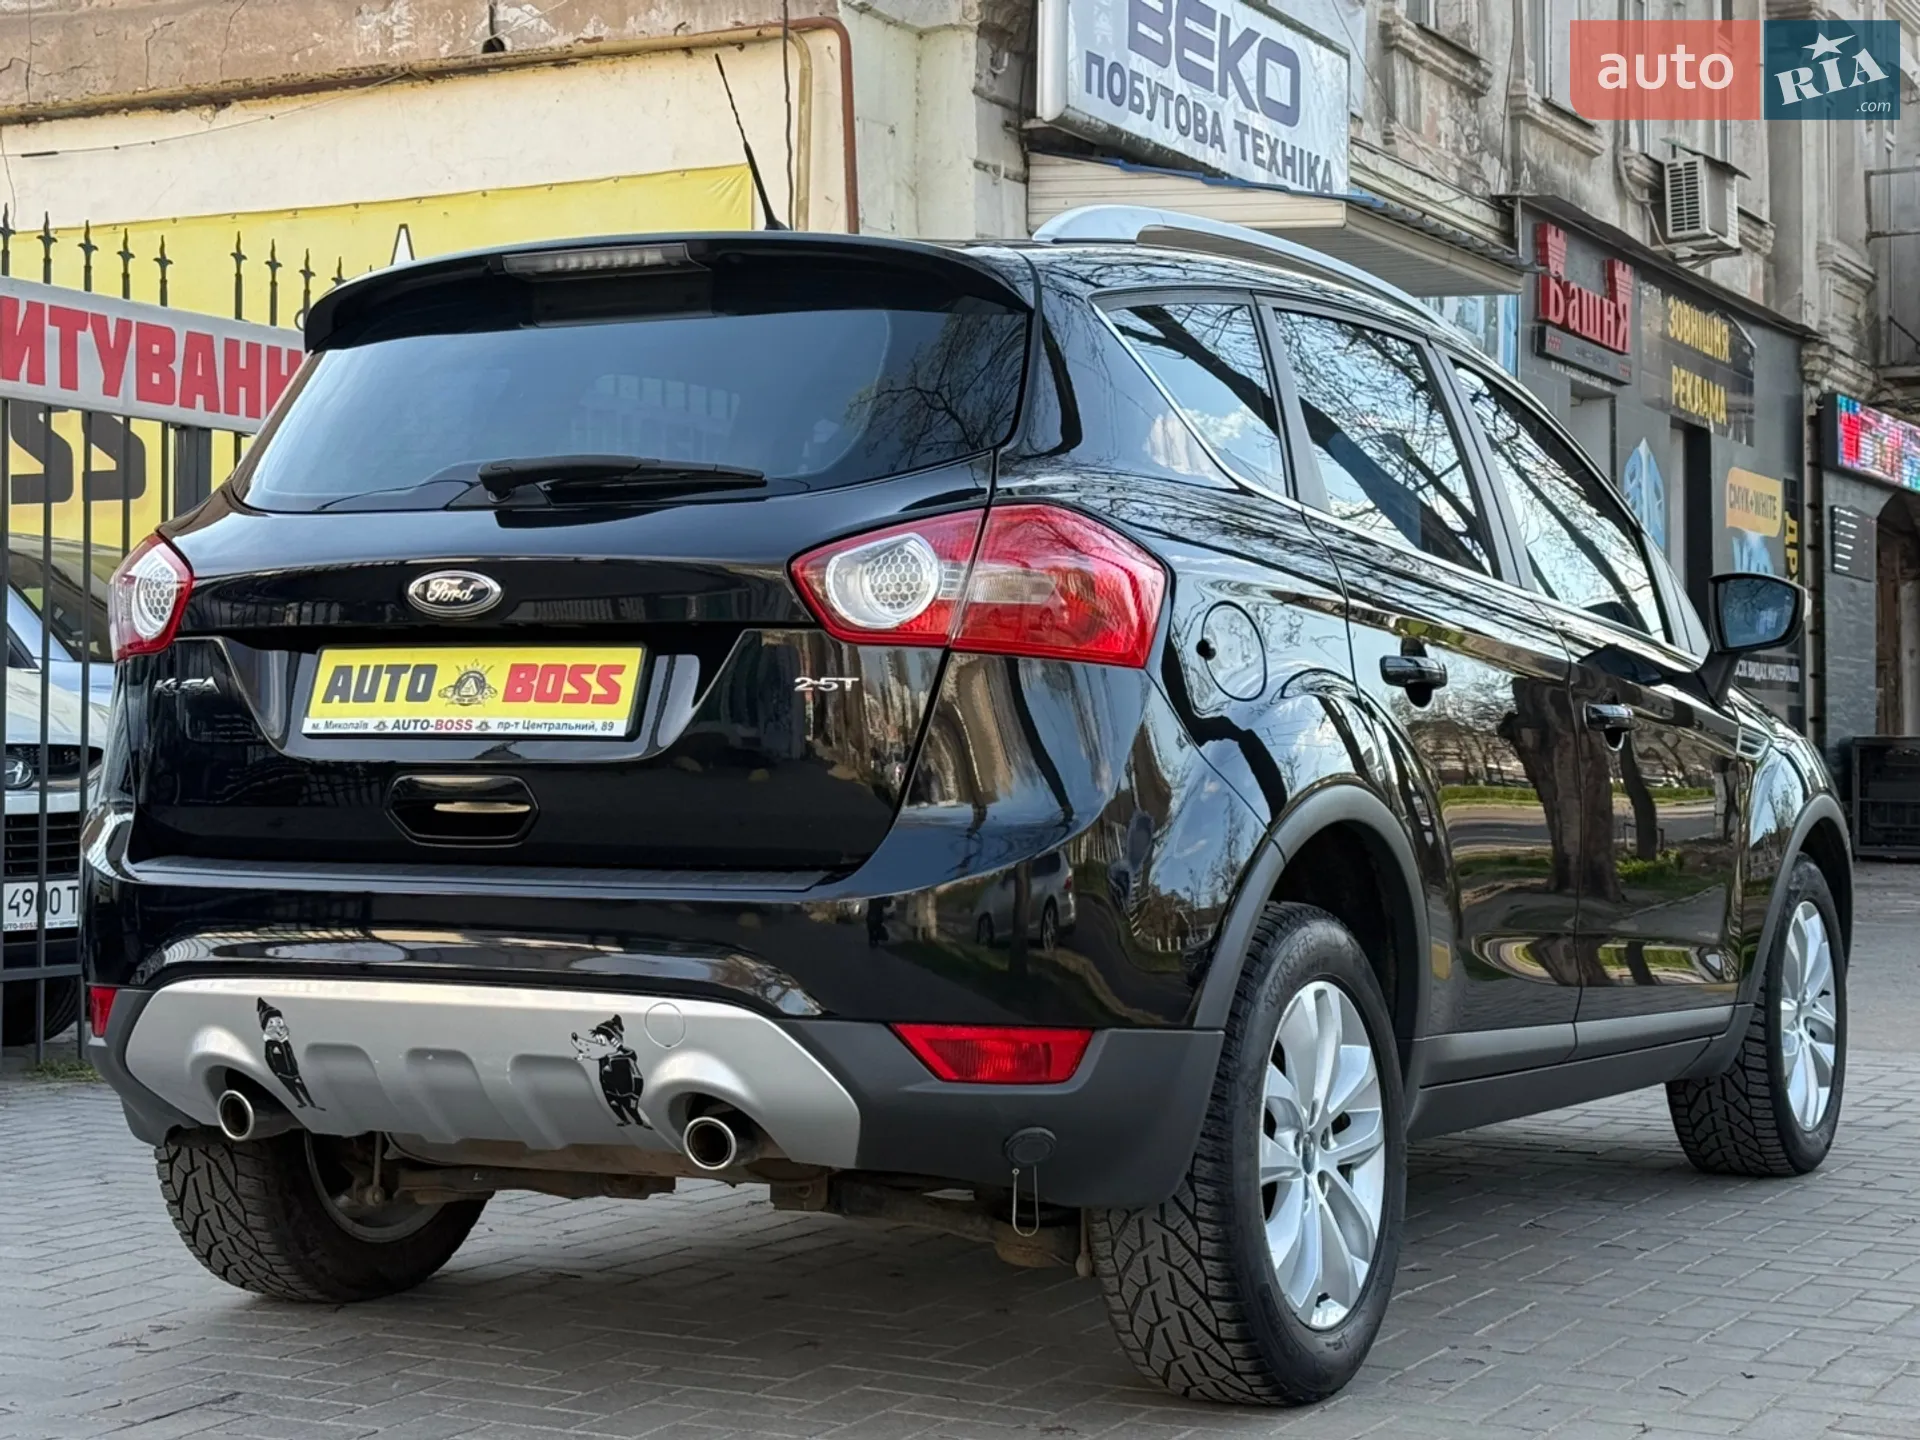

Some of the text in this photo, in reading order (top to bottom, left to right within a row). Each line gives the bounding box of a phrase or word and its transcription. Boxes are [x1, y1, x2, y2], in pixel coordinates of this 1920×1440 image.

[1128, 0, 1300, 128] BEKO
[1085, 50, 1333, 194] ПОБУТОВА ТЕХНІКА
[1668, 294, 1729, 363] ЗОВНІШНЯ
[1672, 364, 1727, 425] РЕКЛАМА
[427, 578, 474, 602] Ford
[321, 664, 626, 704] AUTO BOSS
[323, 720, 369, 731] Миколаїв
[391, 719, 473, 731] AUTO-BOSS
[601, 721, 614, 731] 89
[8, 887, 60, 917] 490
